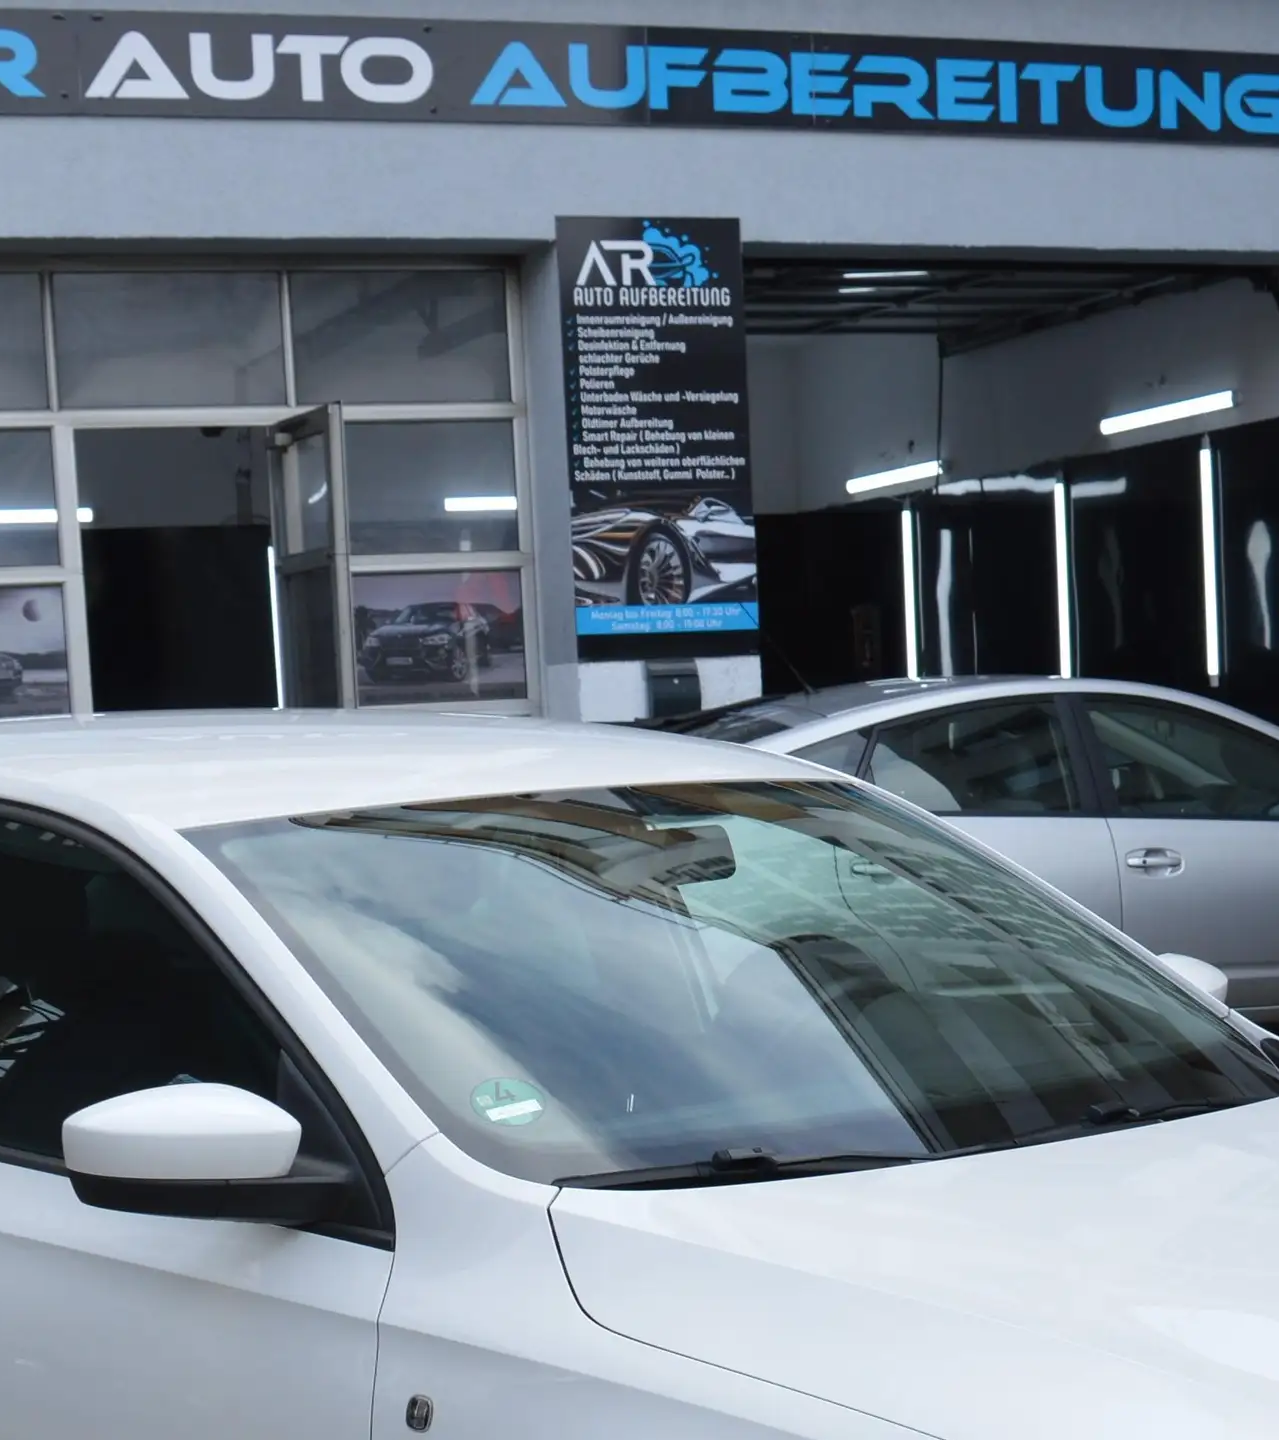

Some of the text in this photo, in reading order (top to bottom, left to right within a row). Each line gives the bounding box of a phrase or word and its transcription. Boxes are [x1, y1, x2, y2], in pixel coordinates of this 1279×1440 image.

[84, 30, 434, 104] AUTO
[575, 240, 657, 286] AR
[573, 287, 731, 307] AUTO AUFBEREITUNG
[576, 313, 661, 327] Innenraumreinigung
[577, 327, 655, 340] Scheibenreinigung
[579, 365, 635, 379] Polsterpflege
[580, 378, 615, 389] Polieren
[581, 404, 637, 416] Motorwäsche
[581, 418, 674, 430] Oldtimer Aufbereitung
[582, 430, 609, 441] Smart
[609, 430, 638, 443] Repair
